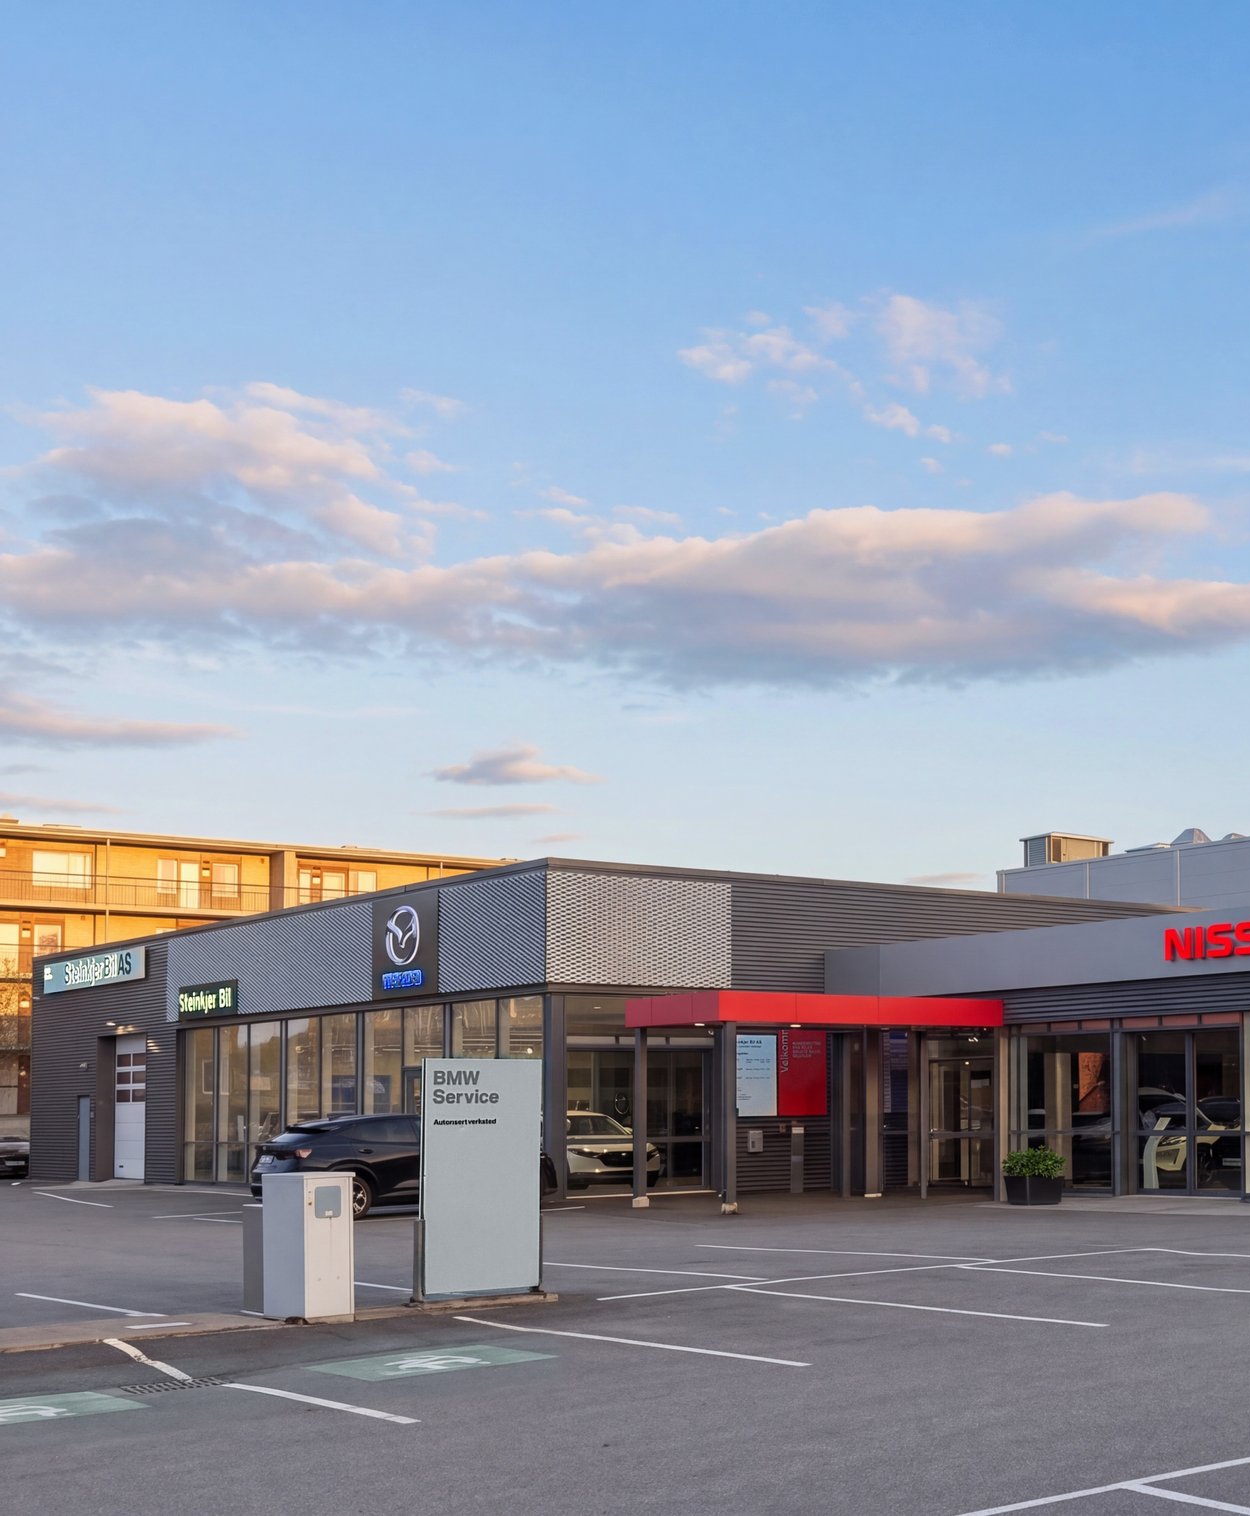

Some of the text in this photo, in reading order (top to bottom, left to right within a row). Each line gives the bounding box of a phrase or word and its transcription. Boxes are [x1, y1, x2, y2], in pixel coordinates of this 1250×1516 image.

[64, 956, 105, 986] Steinkjer
[104, 952, 118, 979] Bil
[118, 951, 132, 976] AS
[178, 986, 232, 1015] Steinkjer Bil
[433, 1070, 480, 1085] BMW
[432, 1088, 500, 1104] Service
